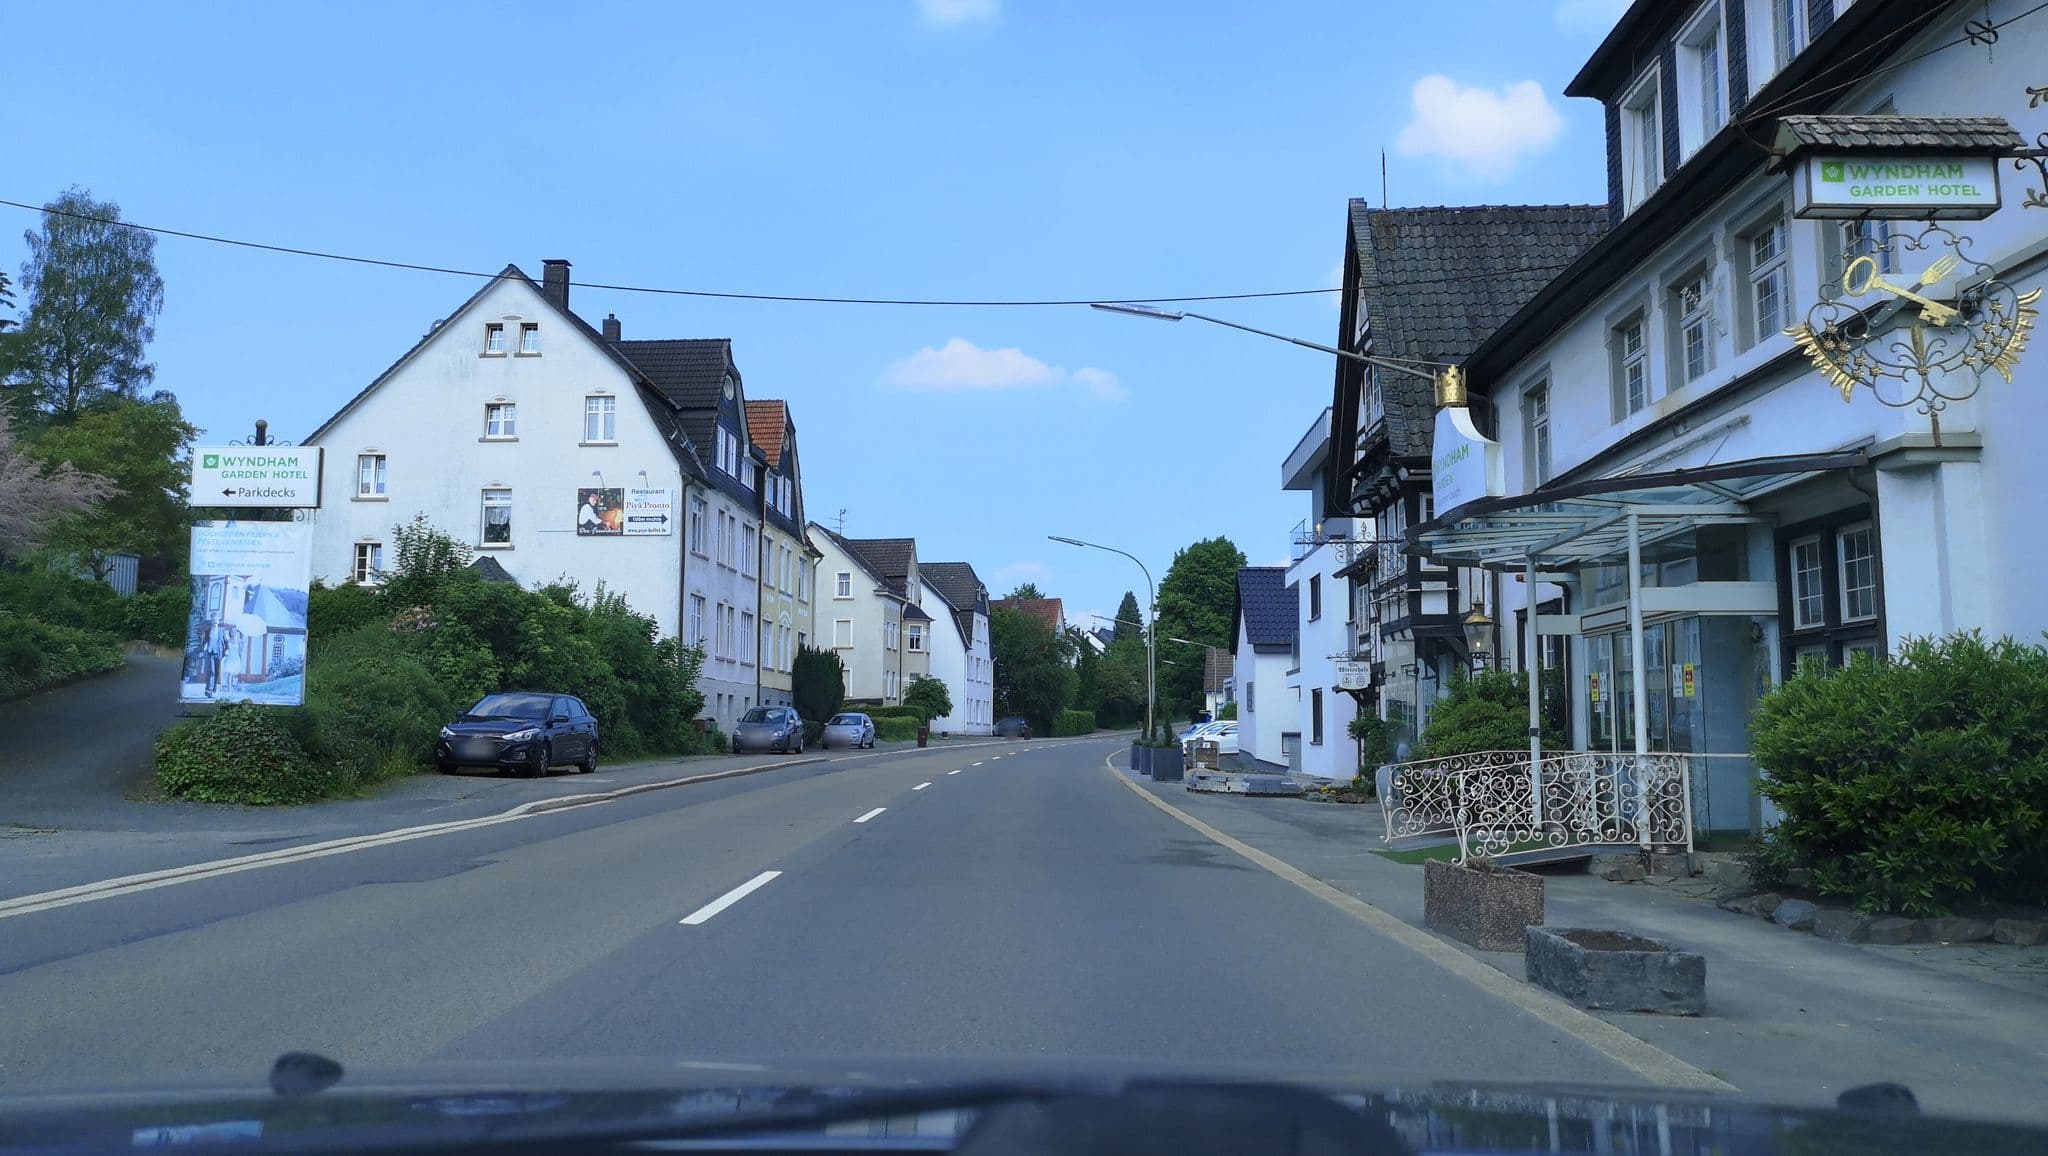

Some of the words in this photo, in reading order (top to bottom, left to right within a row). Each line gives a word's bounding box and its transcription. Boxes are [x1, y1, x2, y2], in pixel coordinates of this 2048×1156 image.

[1849, 164, 1964, 180] WYNDHAM
[1850, 185, 1920, 197] GARDEN
[1928, 185, 1981, 196] HOTEL
[222, 456, 299, 467] WYNDHAM
[221, 470, 268, 479] GARDEN
[272, 470, 308, 479] HOTEL
[238, 487, 296, 498] Parkdecks
